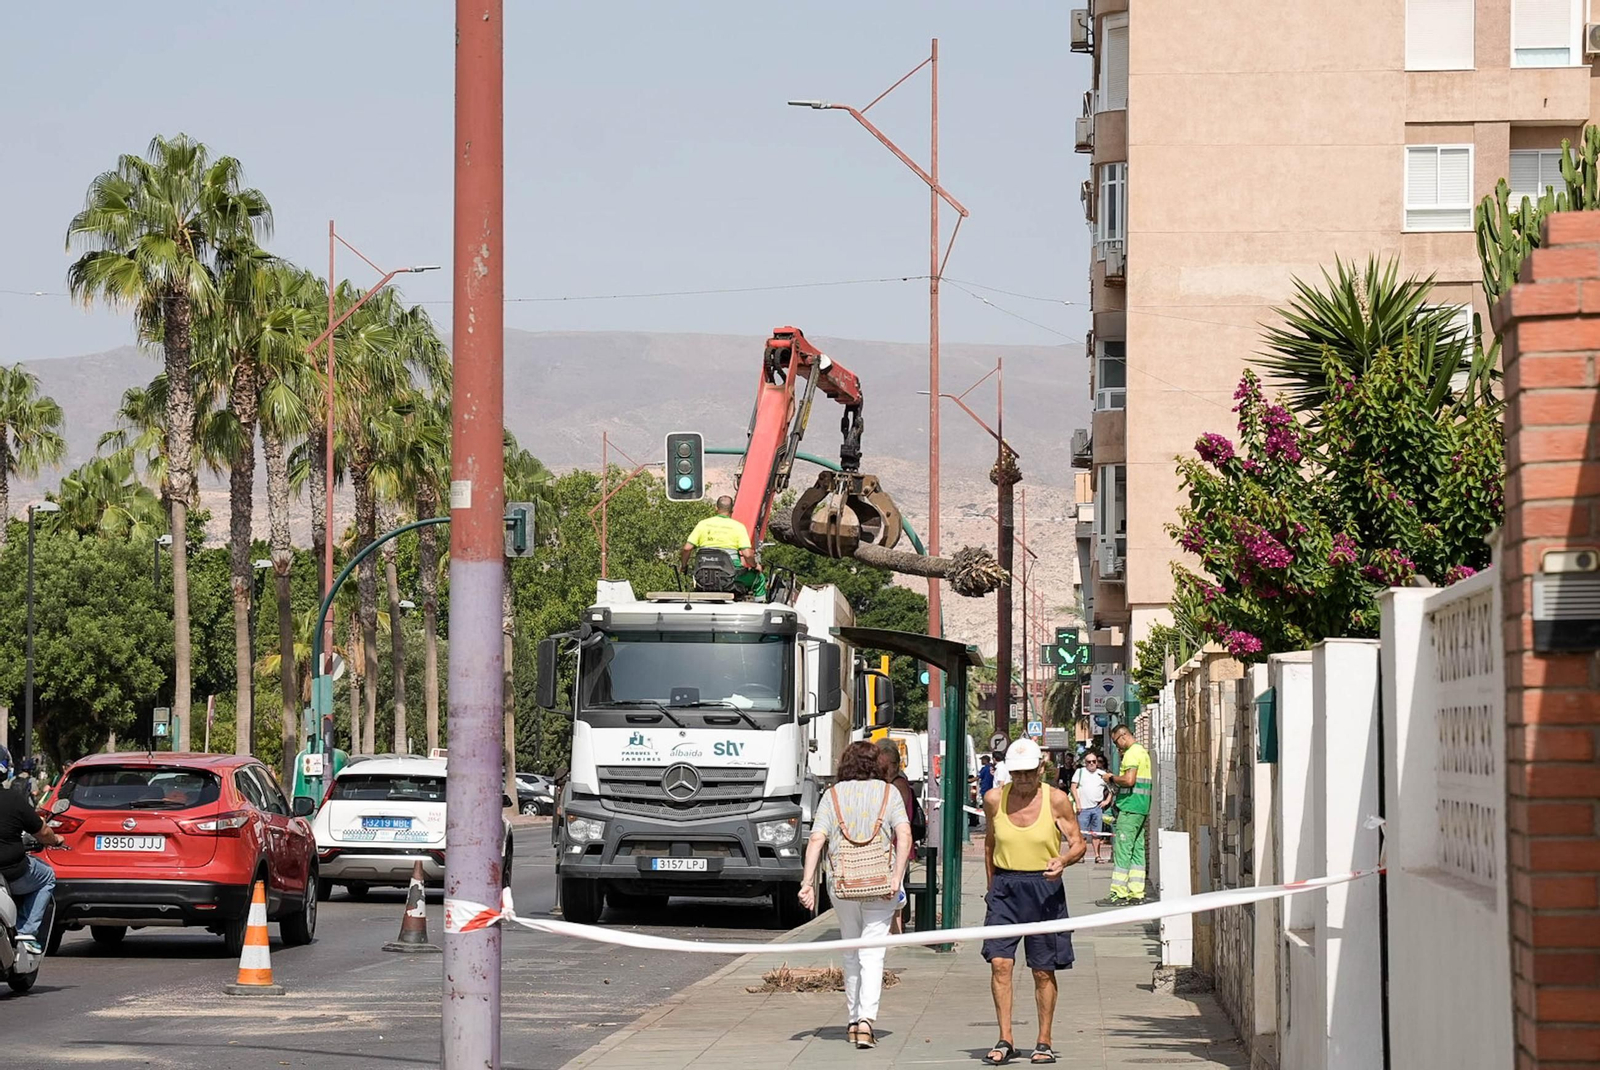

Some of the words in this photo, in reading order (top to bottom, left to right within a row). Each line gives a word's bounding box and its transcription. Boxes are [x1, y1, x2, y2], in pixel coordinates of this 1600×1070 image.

[670, 749, 703, 757] albaida
[368, 818, 391, 828] 3219
[393, 818, 410, 828] MBL
[104, 837, 134, 849] 9950
[139, 837, 162, 849] JJJ
[660, 859, 683, 869] 3157
[686, 860, 705, 870] LPJ
